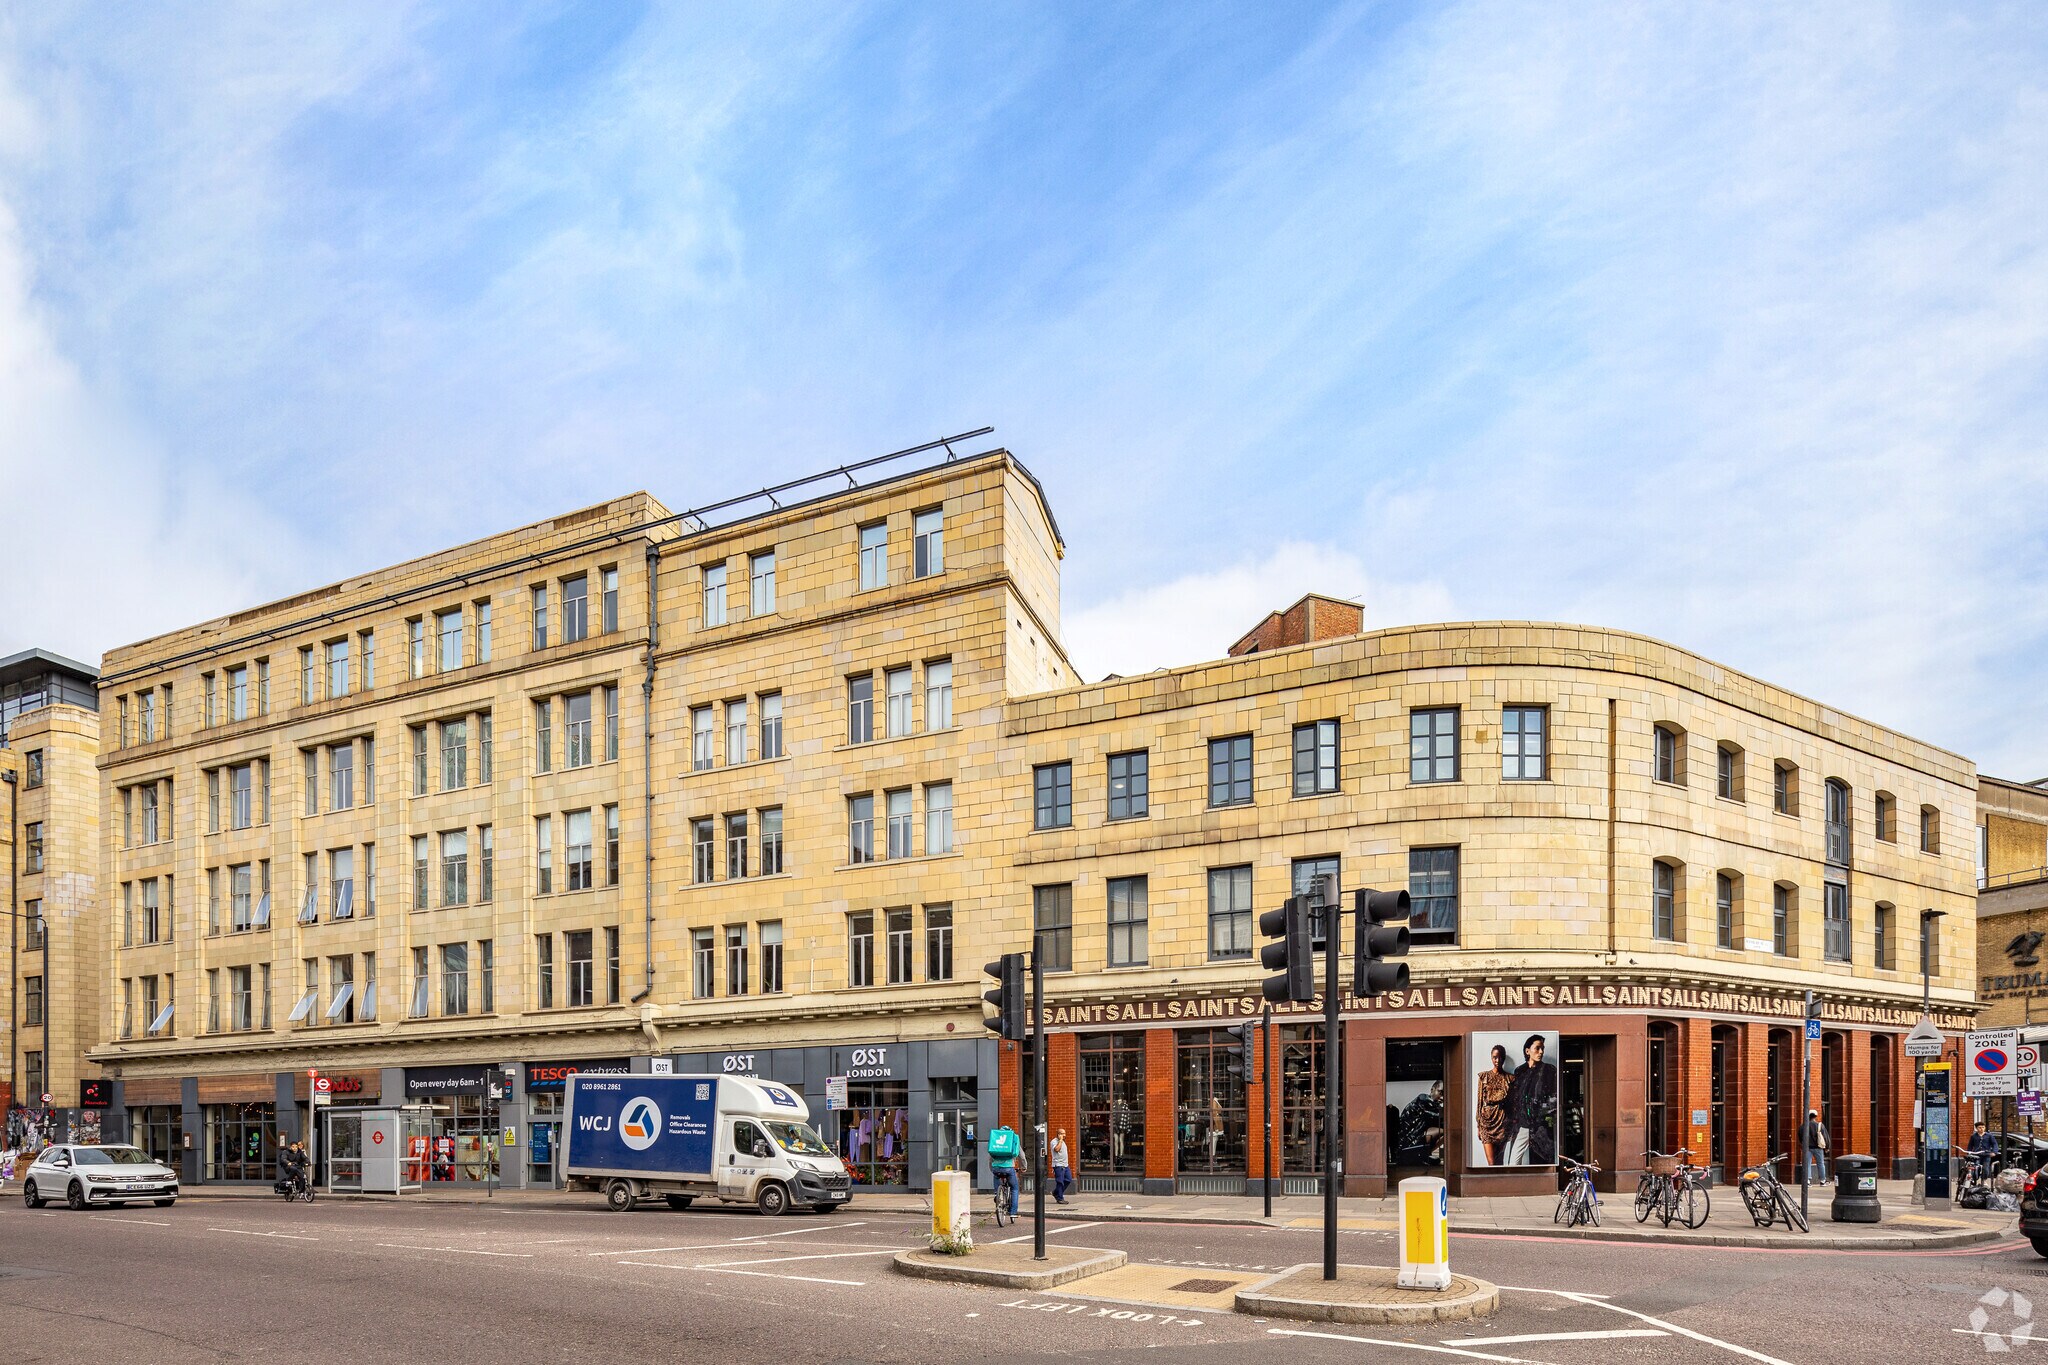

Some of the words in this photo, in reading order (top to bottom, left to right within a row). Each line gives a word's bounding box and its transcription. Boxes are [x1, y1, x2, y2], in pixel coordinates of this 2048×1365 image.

[1982, 971, 2048, 991] TRUM
[1749, 995, 1806, 1017] ALLSAINT
[1968, 1032, 2014, 1040] Controlled
[1974, 1039, 2007, 1048] ZONE
[722, 1054, 755, 1072] ØST
[851, 1048, 887, 1067] ØST
[530, 1067, 578, 1080] TESCO
[846, 1068, 891, 1078] LONDON
[2017, 1067, 2038, 1075] ONE
[410, 1079, 428, 1089] Open
[428, 1079, 446, 1089] every
[447, 1078, 459, 1088] day
[460, 1077, 475, 1087] 6am
[607, 1083, 621, 1091] 2861
[579, 1115, 612, 1132] WCJ
[683, 1121, 707, 1129] Clearances
[997, 1299, 1088, 1315] LEFT
[1087, 1306, 1178, 1326] LOOK
